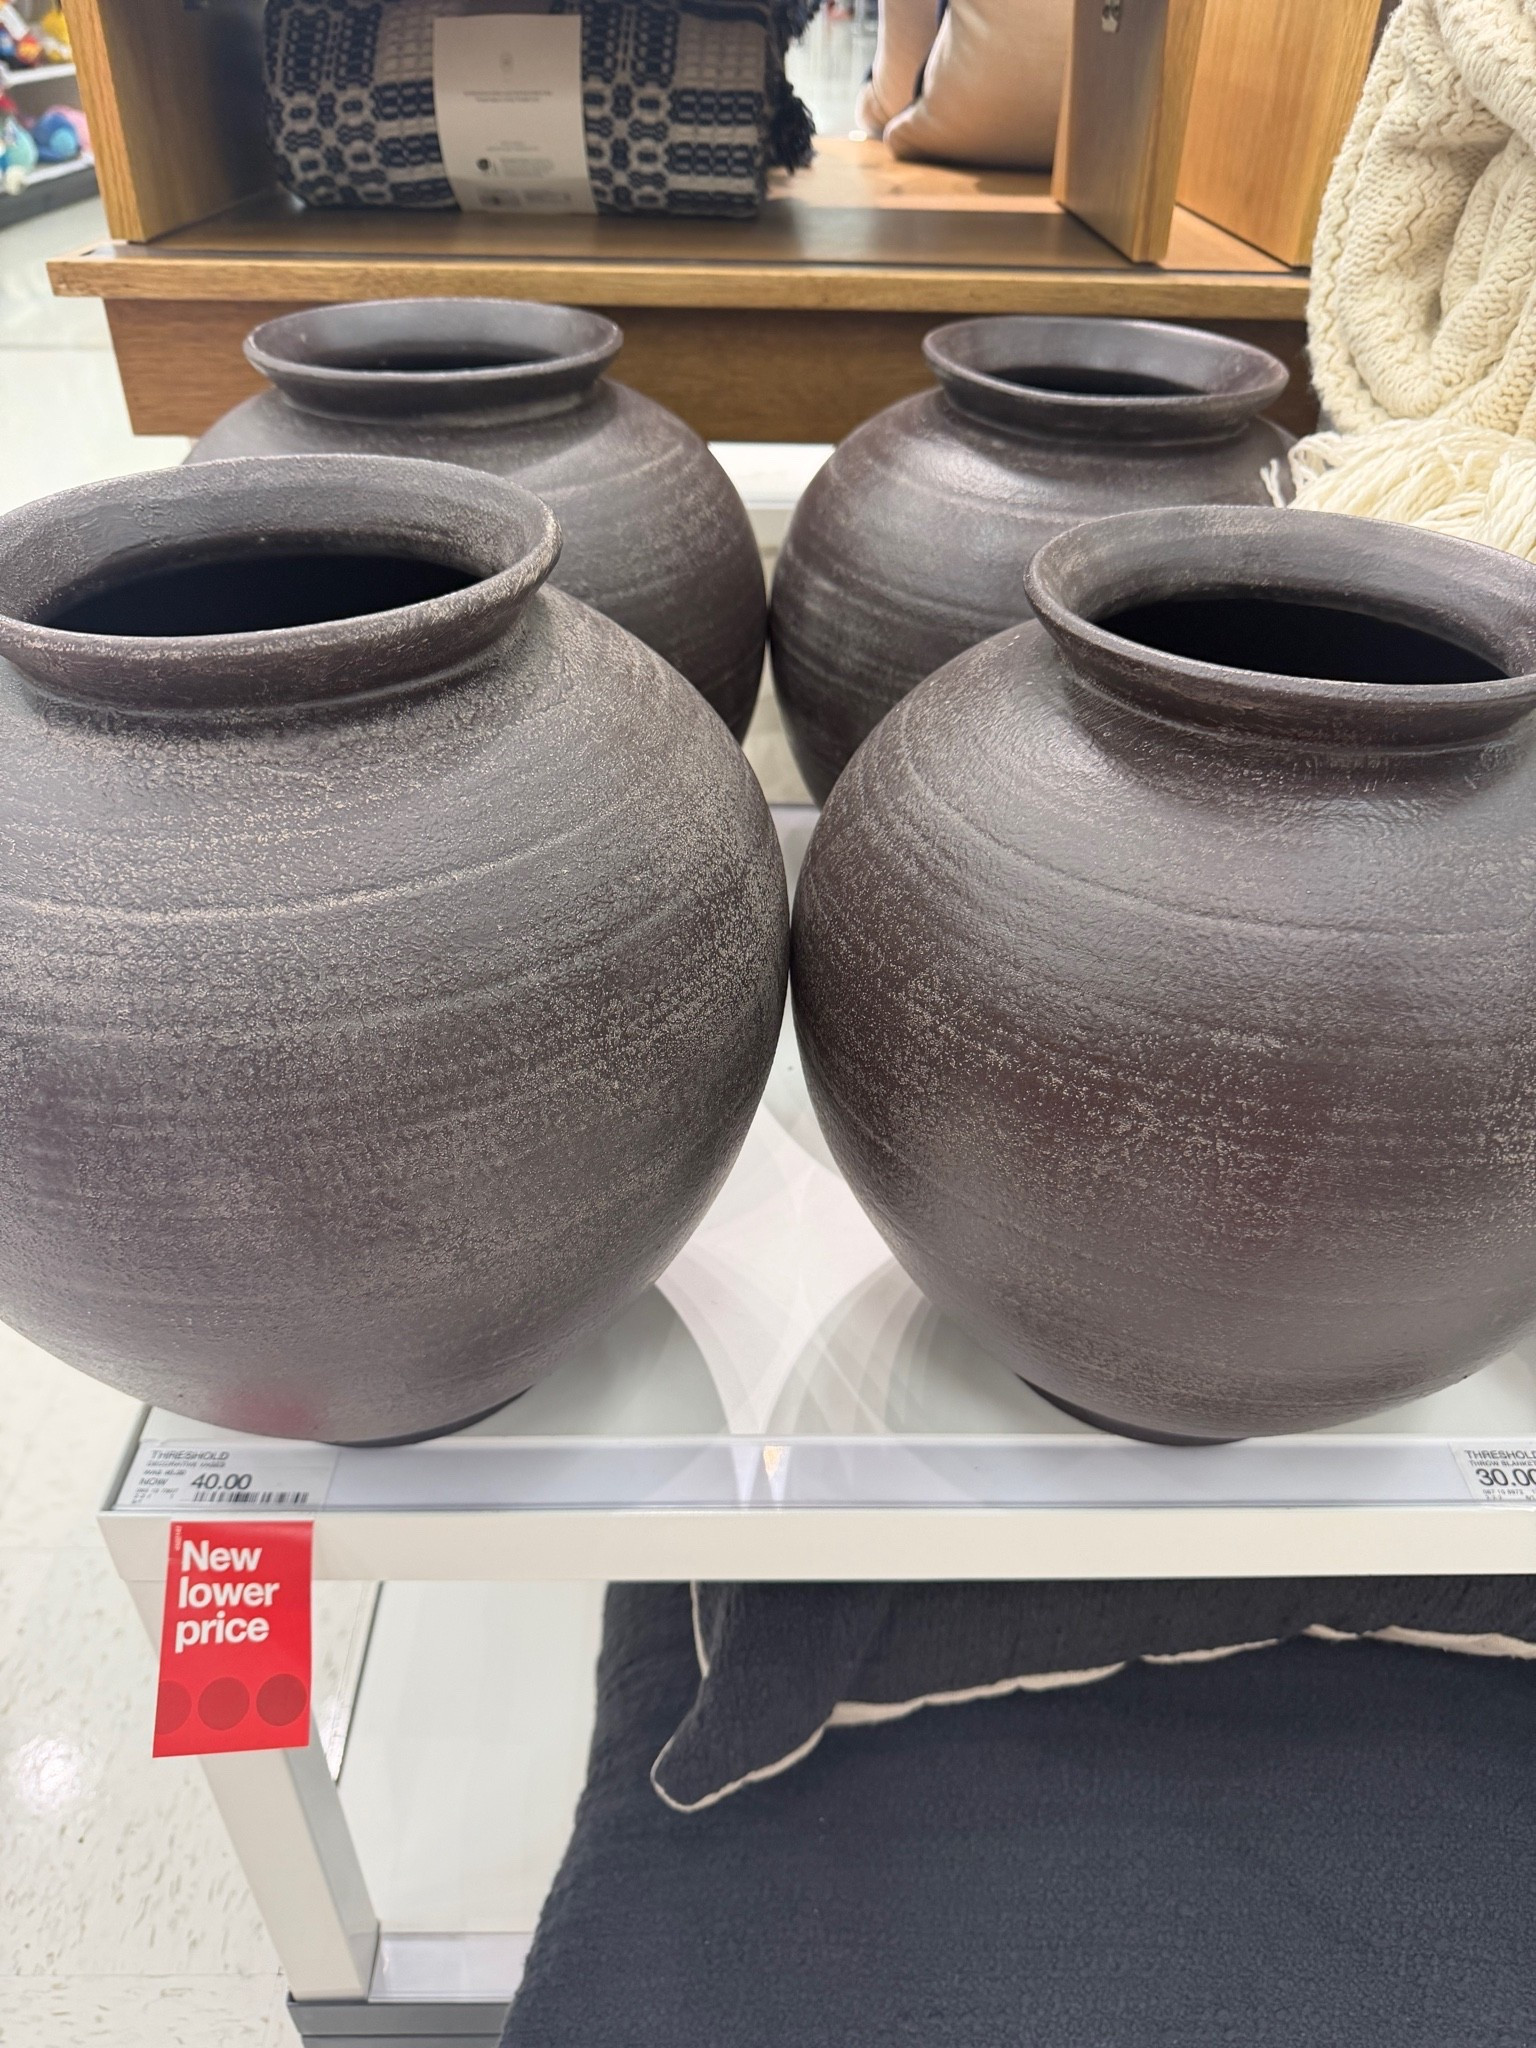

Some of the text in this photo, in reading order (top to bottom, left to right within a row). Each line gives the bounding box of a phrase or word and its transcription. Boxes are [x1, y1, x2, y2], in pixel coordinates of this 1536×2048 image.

[150, 1450, 230, 1460] THRESHOLD
[139, 1477, 169, 1485] NOW
[191, 1473, 252, 1490] 40.00
[181, 1539, 262, 1572] New
[178, 1575, 280, 1609] lower
[174, 1610, 270, 1654] price
